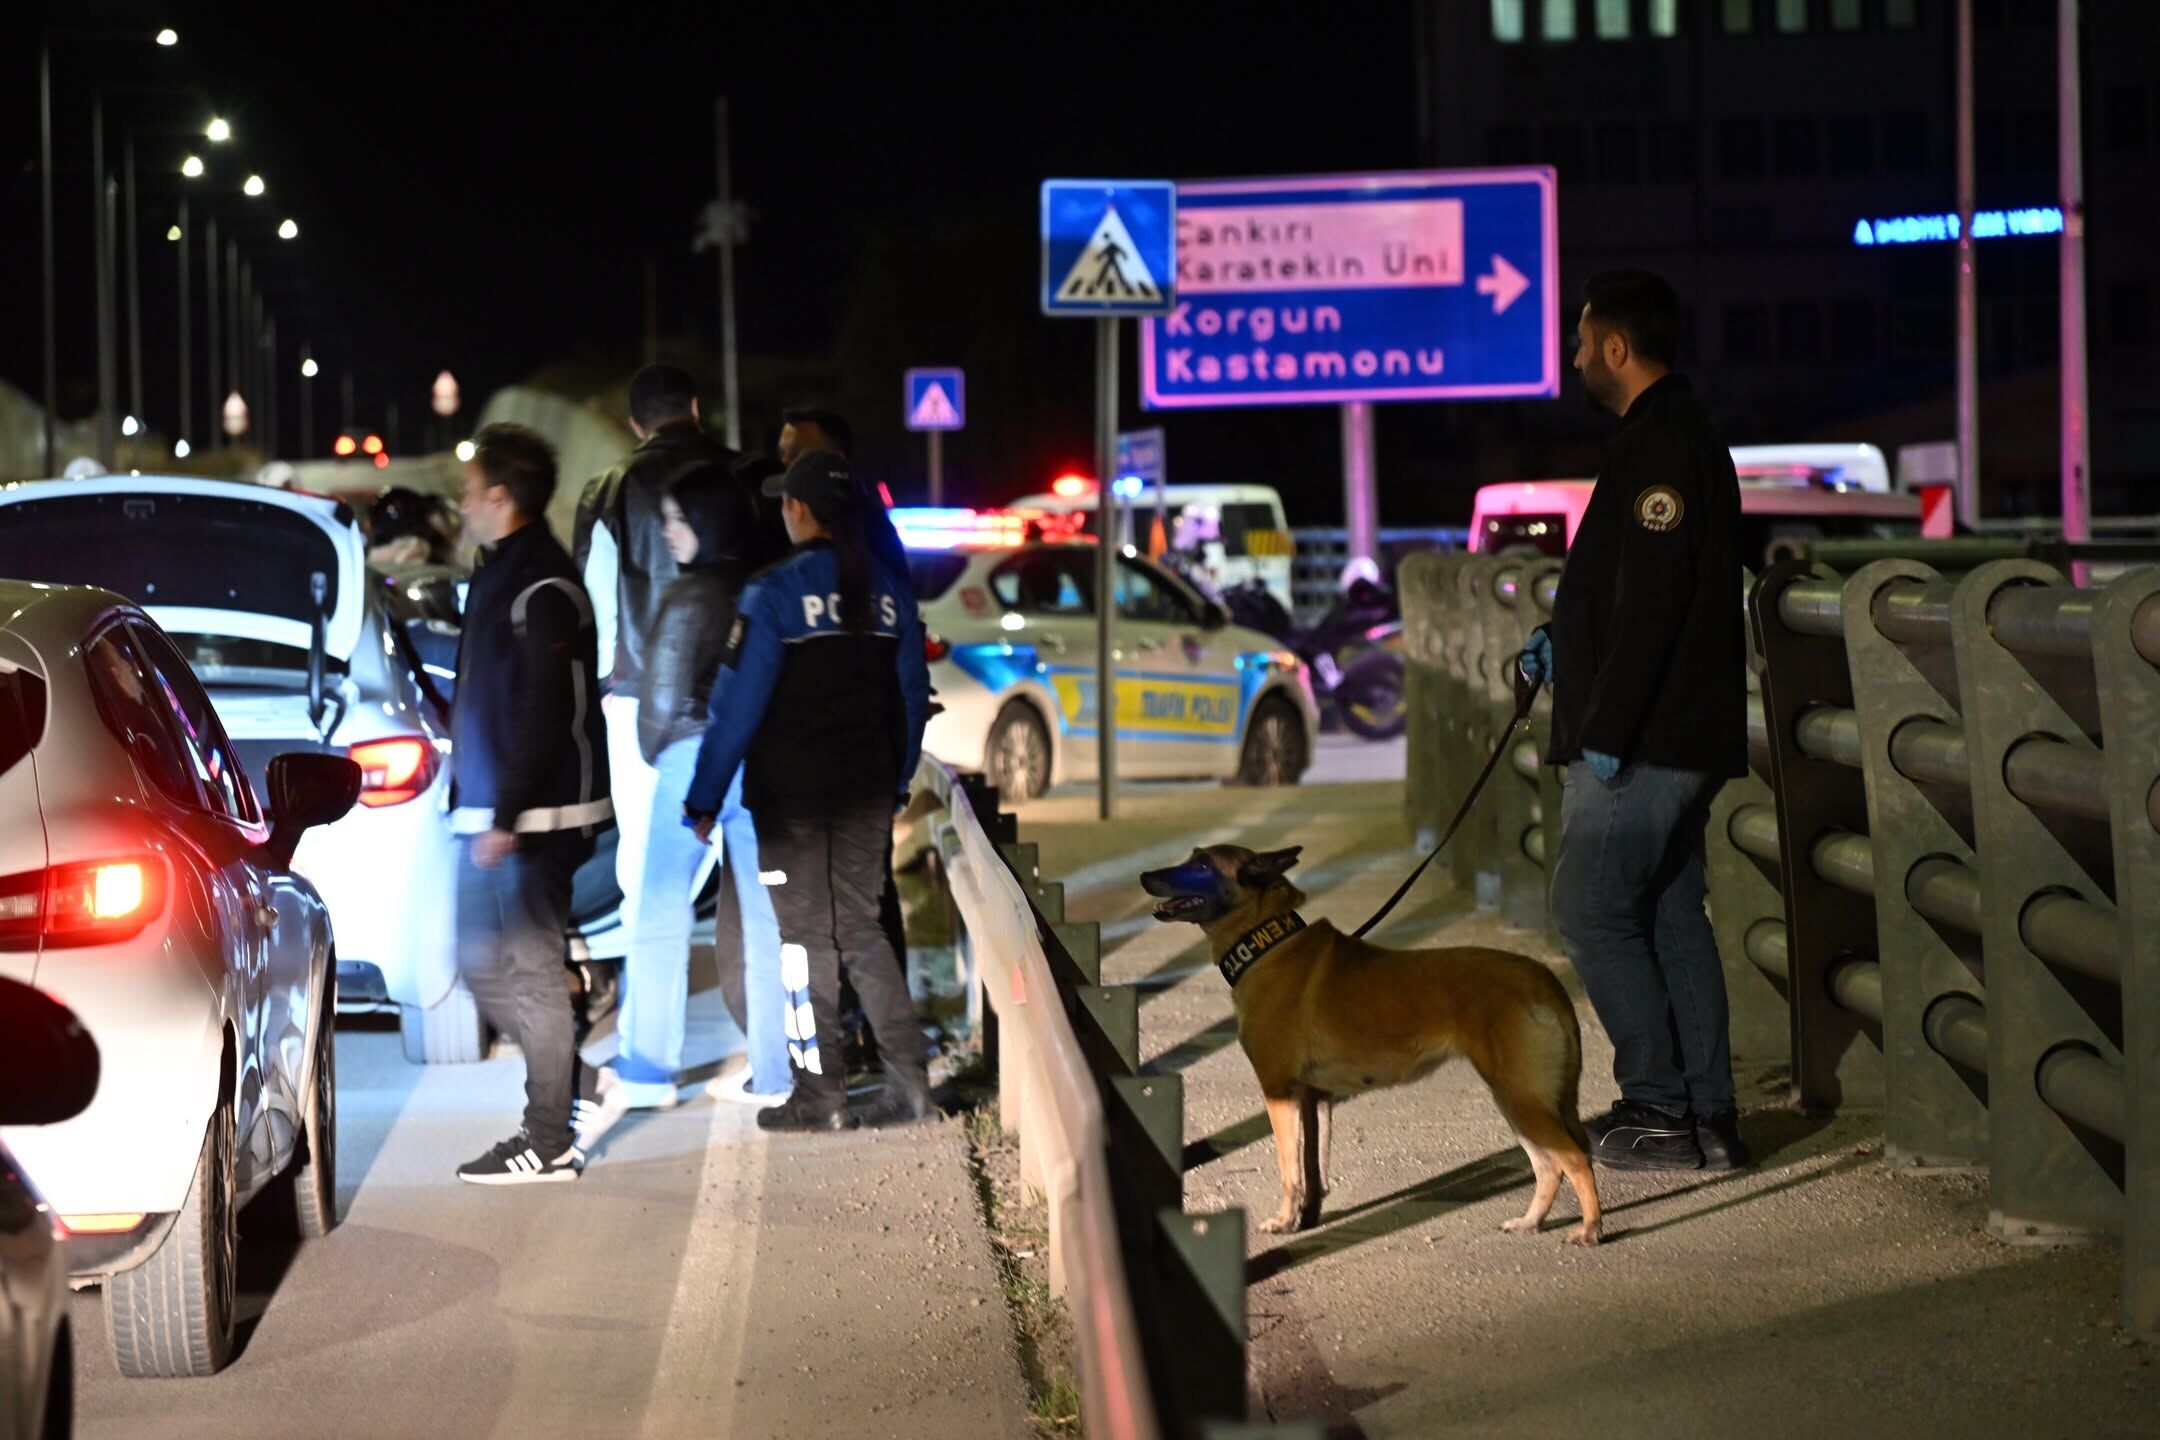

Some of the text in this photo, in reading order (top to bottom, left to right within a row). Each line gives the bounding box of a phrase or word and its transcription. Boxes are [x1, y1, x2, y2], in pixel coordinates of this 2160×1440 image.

[1177, 250, 1364, 282] Karatekin
[1166, 300, 1341, 342] Korgun
[1166, 347, 1445, 383] Kastamonu
